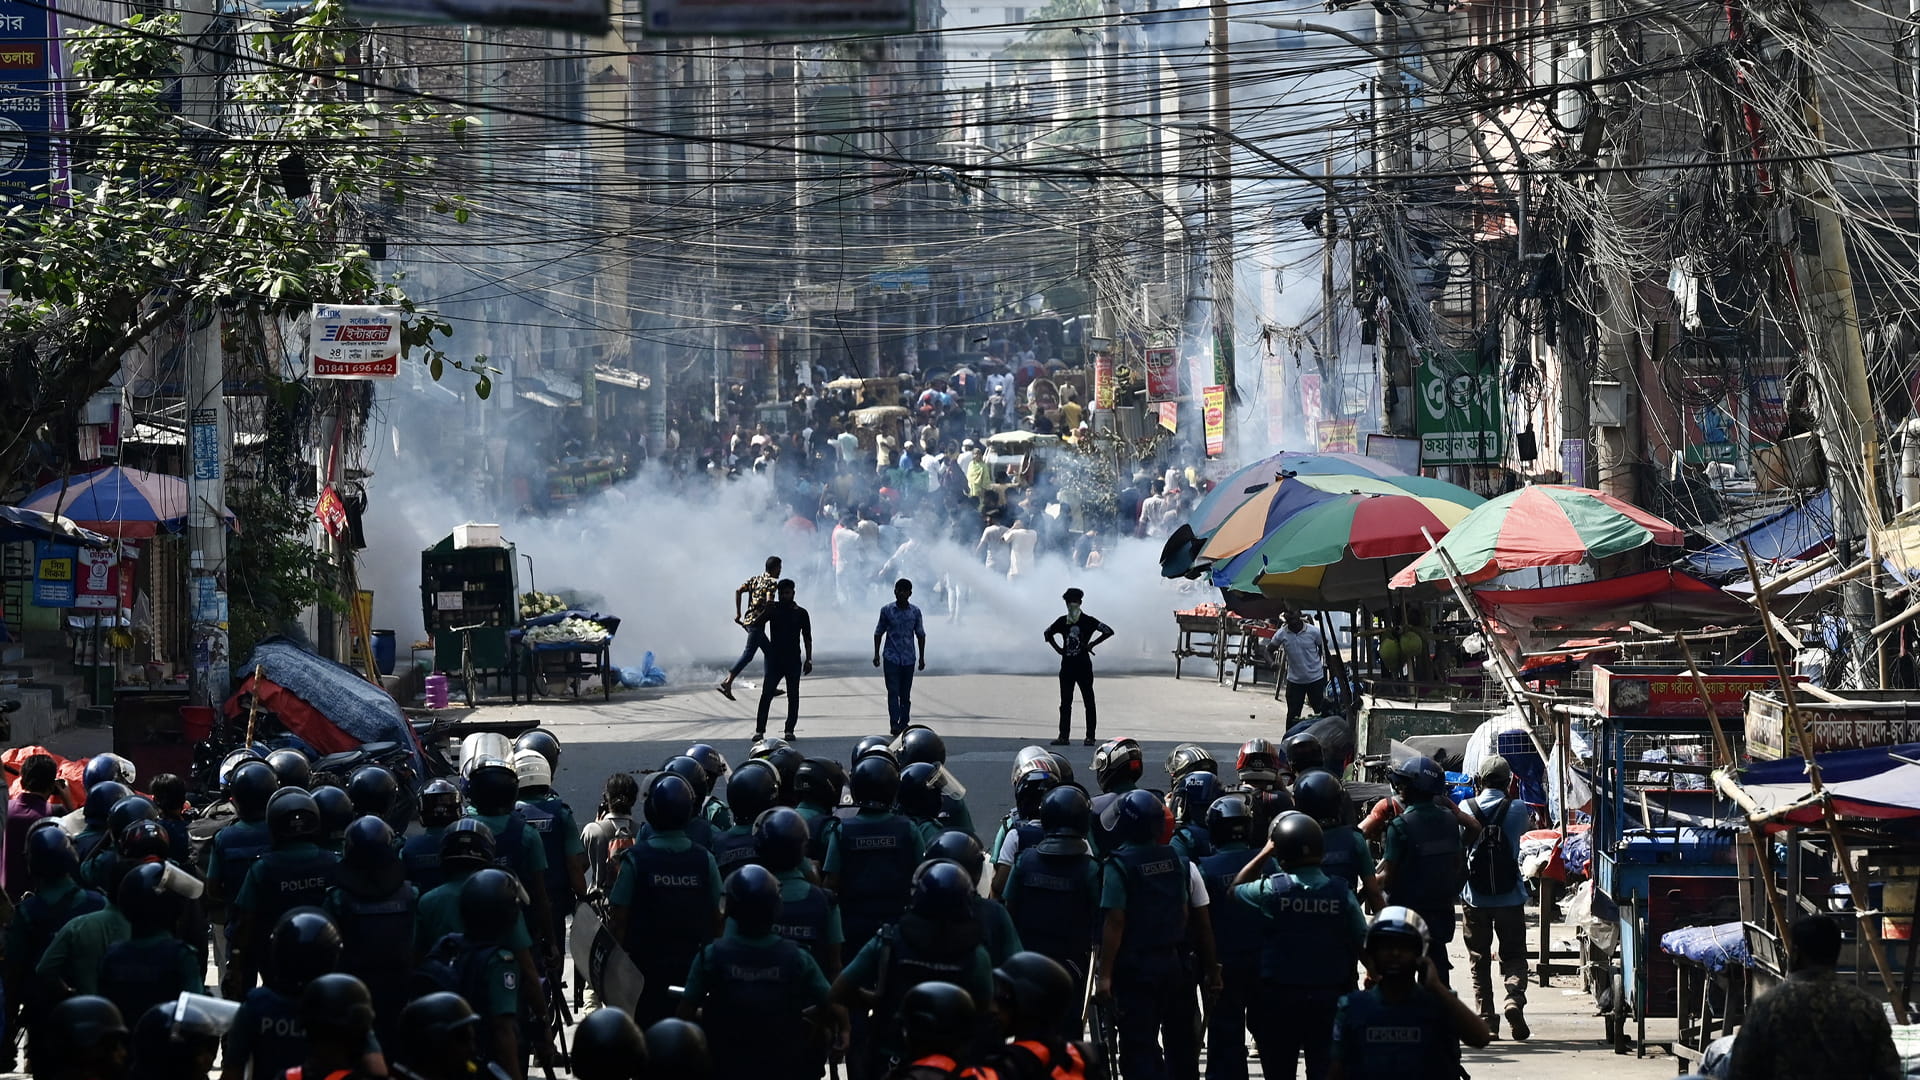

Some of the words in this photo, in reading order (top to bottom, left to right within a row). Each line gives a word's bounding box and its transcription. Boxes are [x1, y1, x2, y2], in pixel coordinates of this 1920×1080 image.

[346, 326, 389, 339] ইন্টারনেট
[318, 364, 349, 373] 01841
[352, 364, 372, 372] 696
[373, 363, 393, 372] 442
[1466, 433, 1495, 450] ফর্মা
[1651, 681, 1669, 695] খাজা
[1671, 678, 1693, 694] গরীবে
[1696, 681, 1726, 694] েওয়াজ
[859, 838, 892, 847] POLICE
[1144, 863, 1172, 873] POLICE
[280, 877, 326, 892] POLICE
[652, 874, 699, 887] POLICE
[1280, 897, 1341, 914] POLICE
[771, 923, 812, 937] OLICE
[261, 1016, 307, 1037] POL
[1371, 1030, 1418, 1041] POLICE
